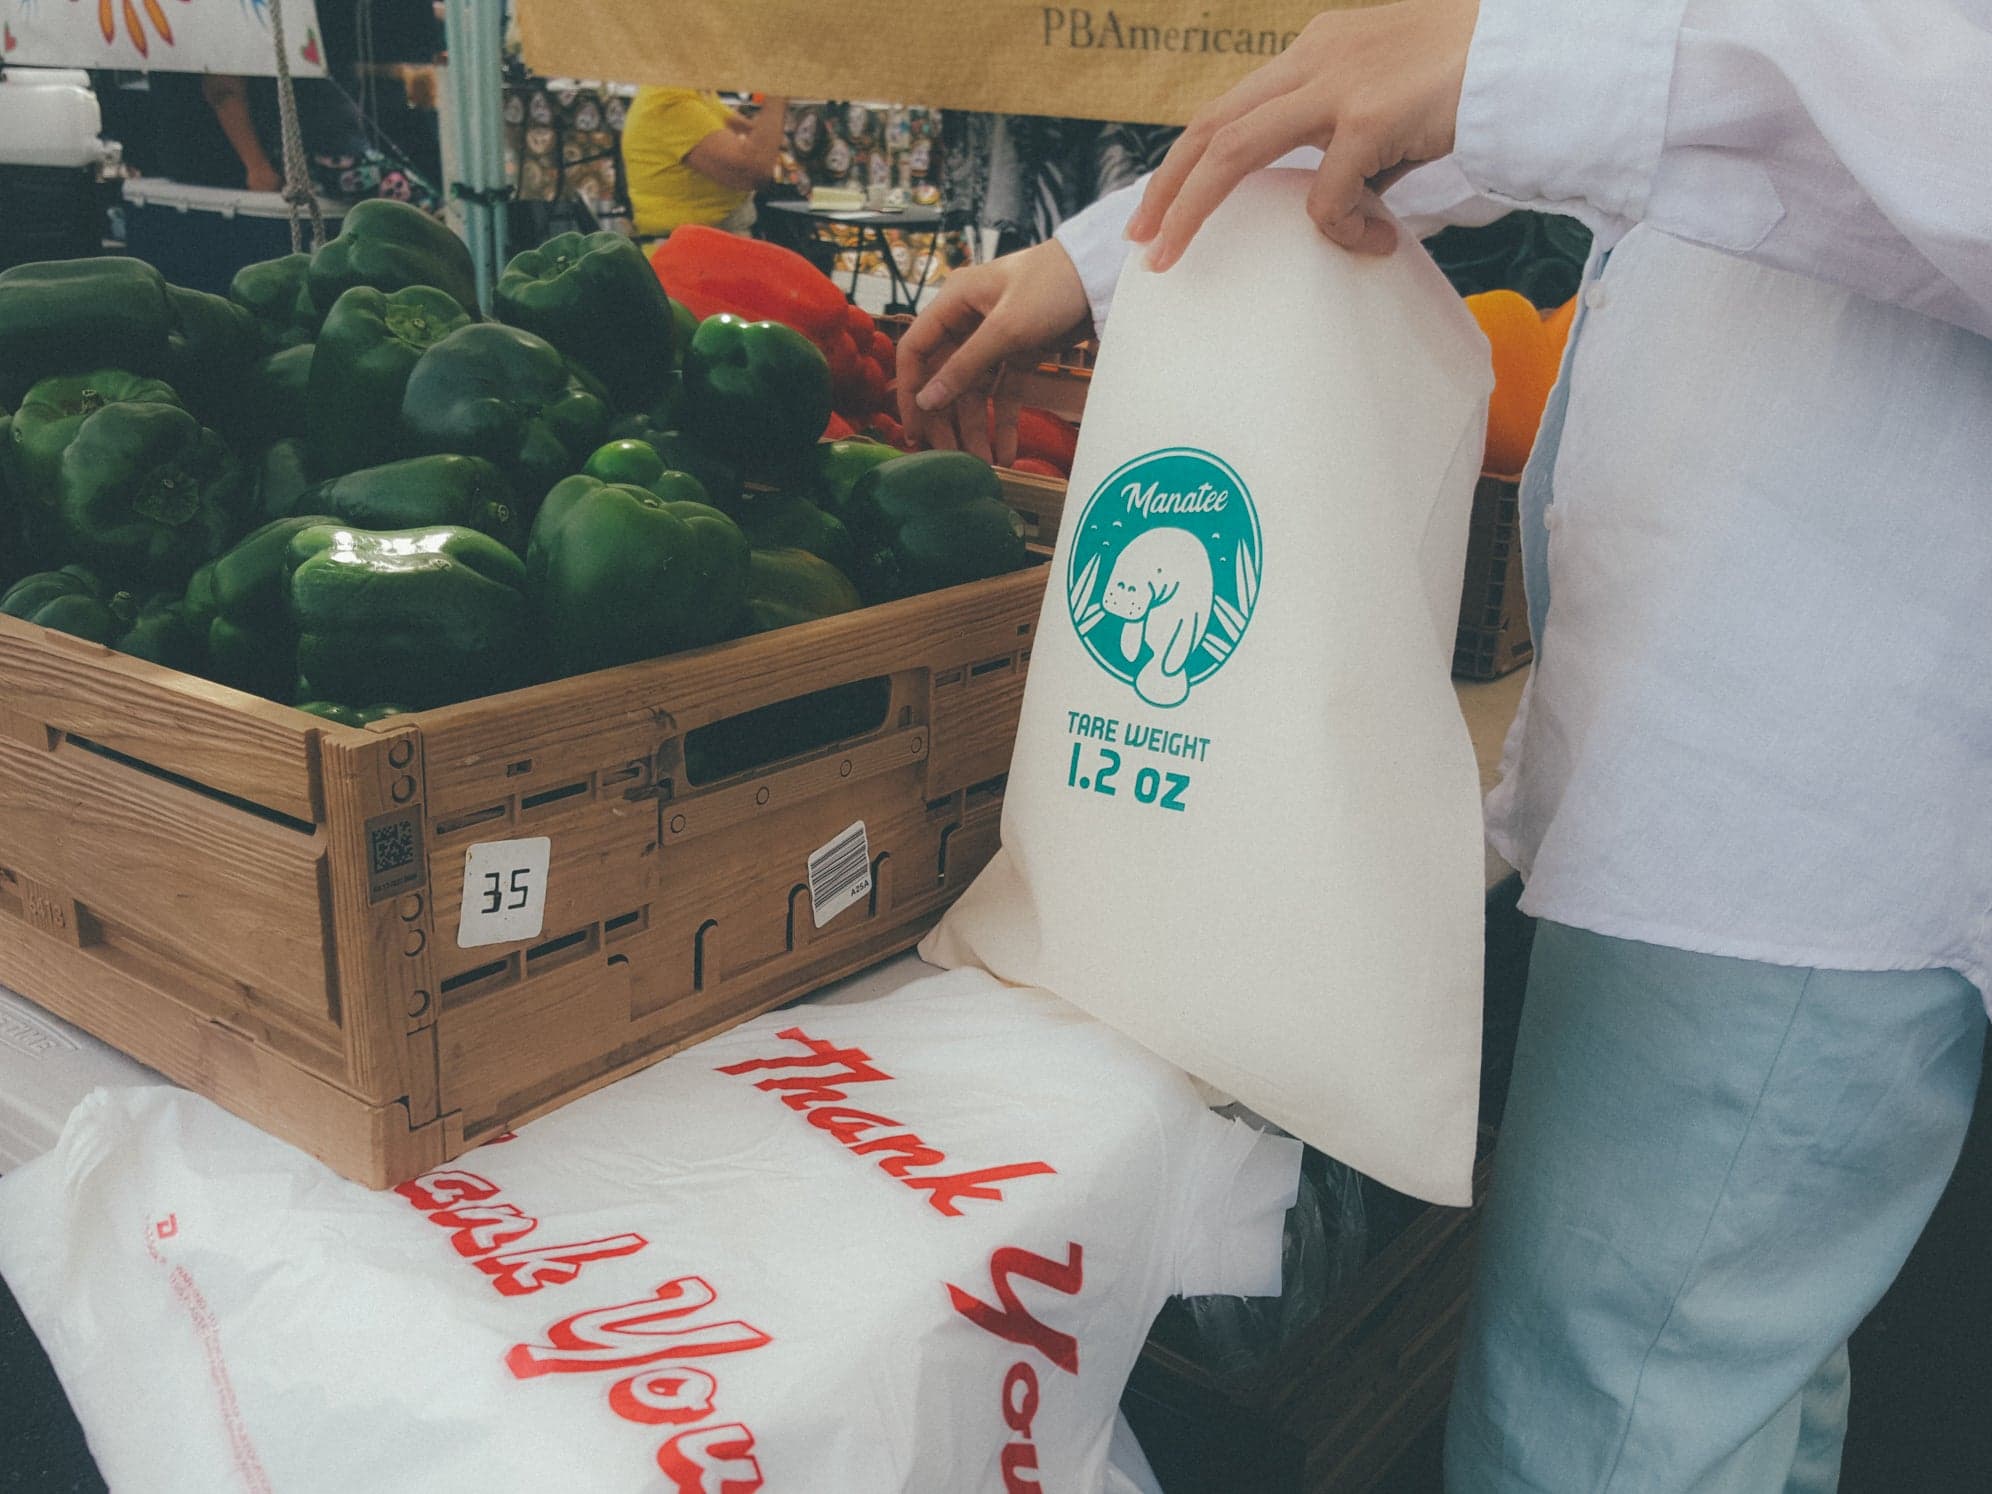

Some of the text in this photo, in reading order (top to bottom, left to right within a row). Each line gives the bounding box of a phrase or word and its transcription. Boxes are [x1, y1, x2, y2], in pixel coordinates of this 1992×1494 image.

[1120, 481, 1229, 518] Manatee
[1068, 710, 1211, 762] TARE WEIGHT
[1068, 742, 1121, 796] 1.2
[481, 868, 530, 914] 35
[715, 1027, 1083, 1494] Thank You
[394, 1132, 774, 1494] ank You
